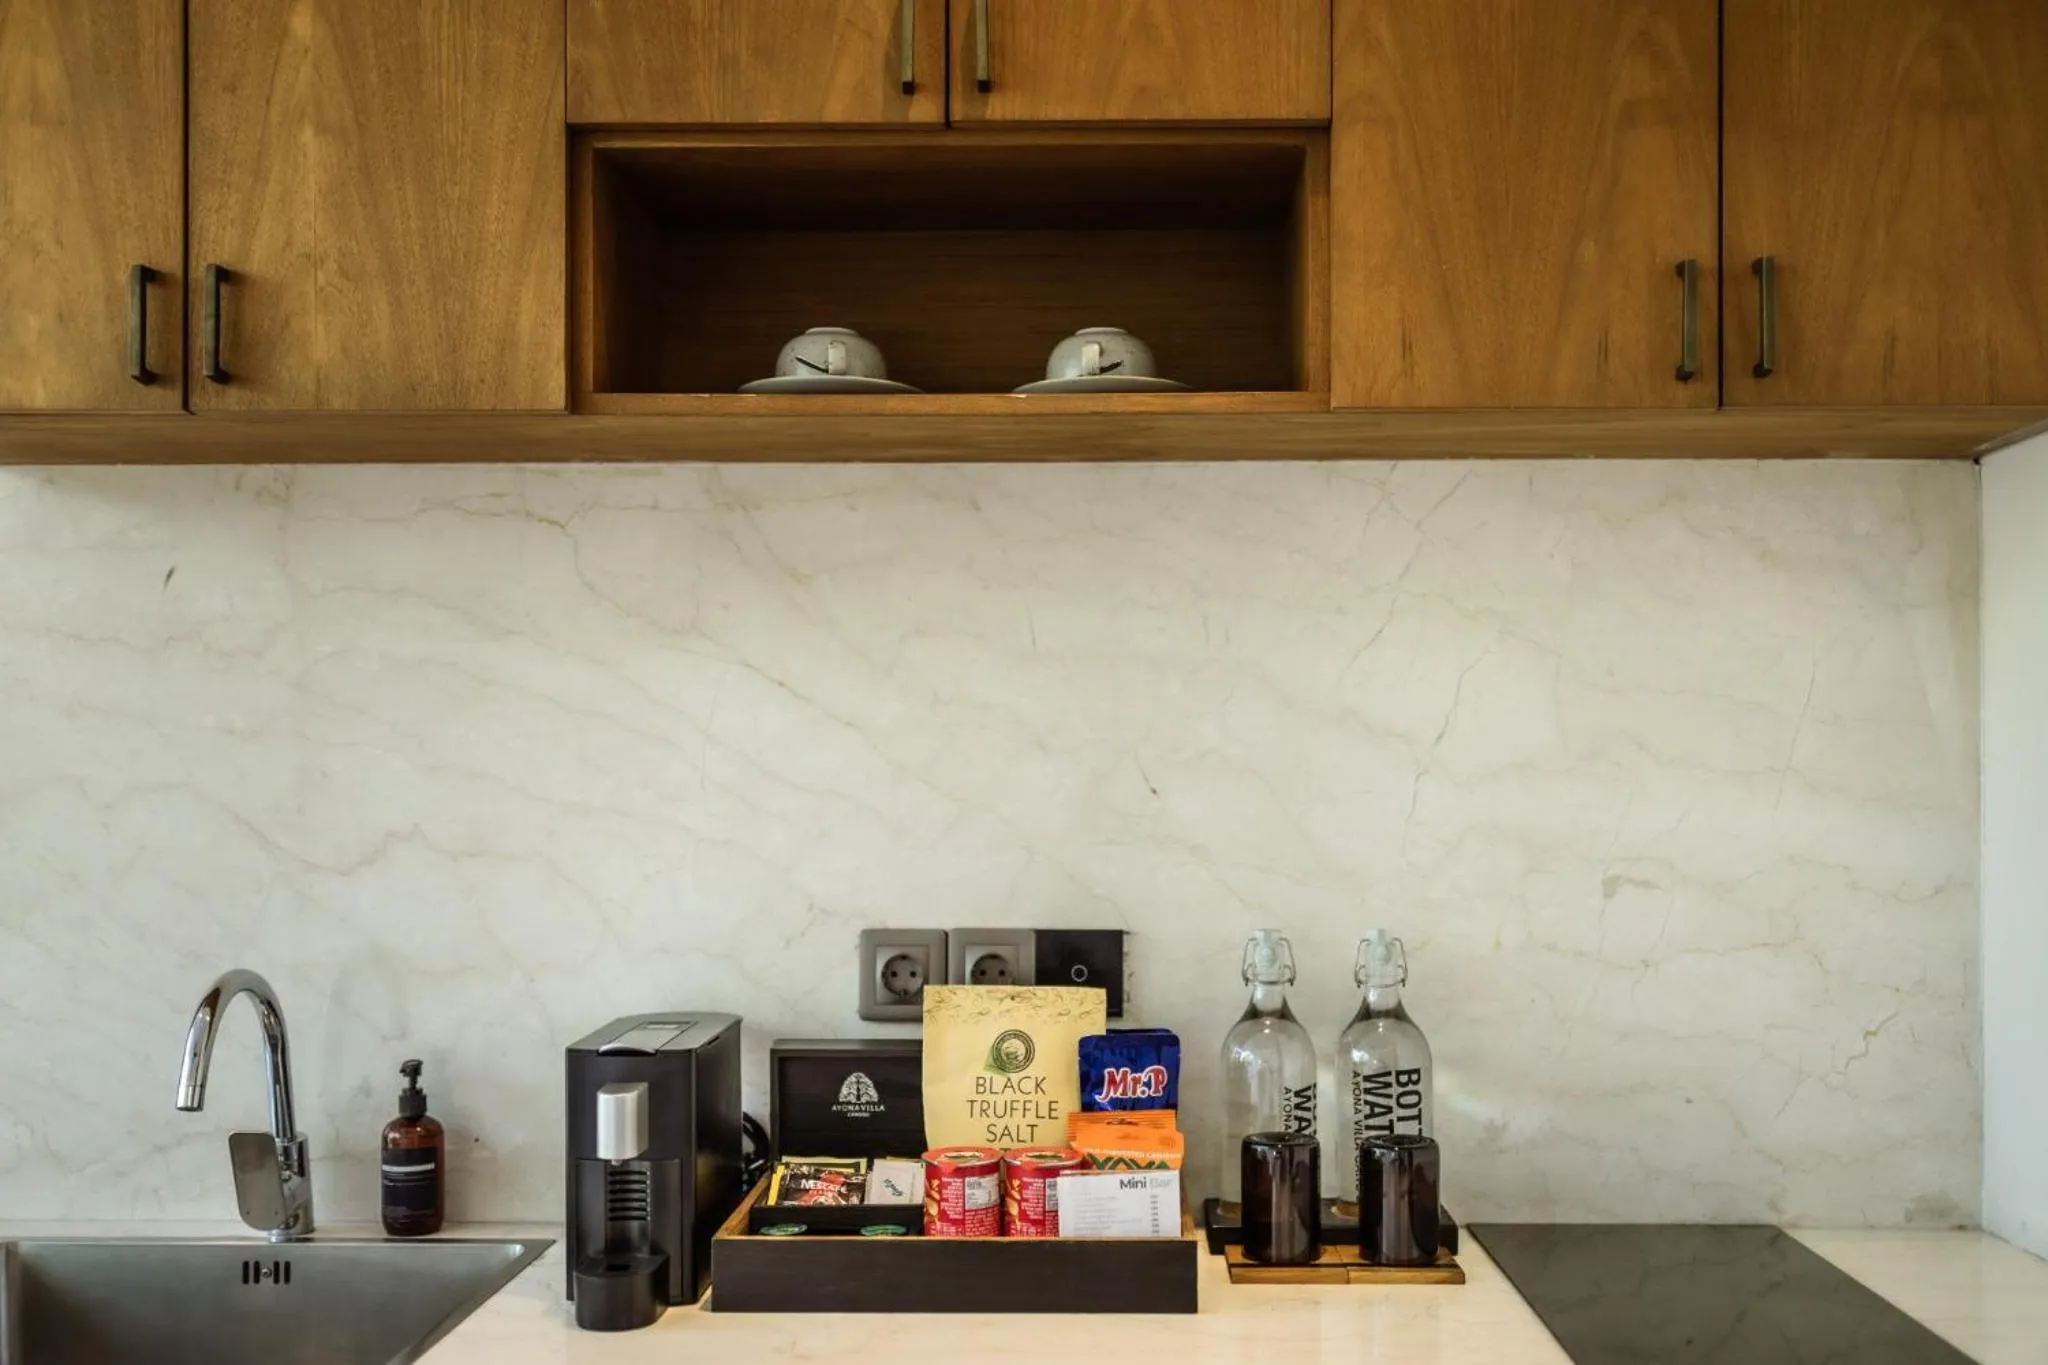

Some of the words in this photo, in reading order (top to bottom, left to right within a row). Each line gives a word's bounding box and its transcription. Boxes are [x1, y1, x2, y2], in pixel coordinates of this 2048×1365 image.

[975, 1075, 1047, 1096] BLACK
[1094, 1065, 1168, 1103] Mr.P
[966, 1099, 1060, 1120] TRUFFLE
[1283, 1086, 1293, 1131] AYONA
[1362, 1071, 1394, 1136] WAT
[986, 1122, 1040, 1143] SALT
[1119, 1176, 1147, 1191] Mini
